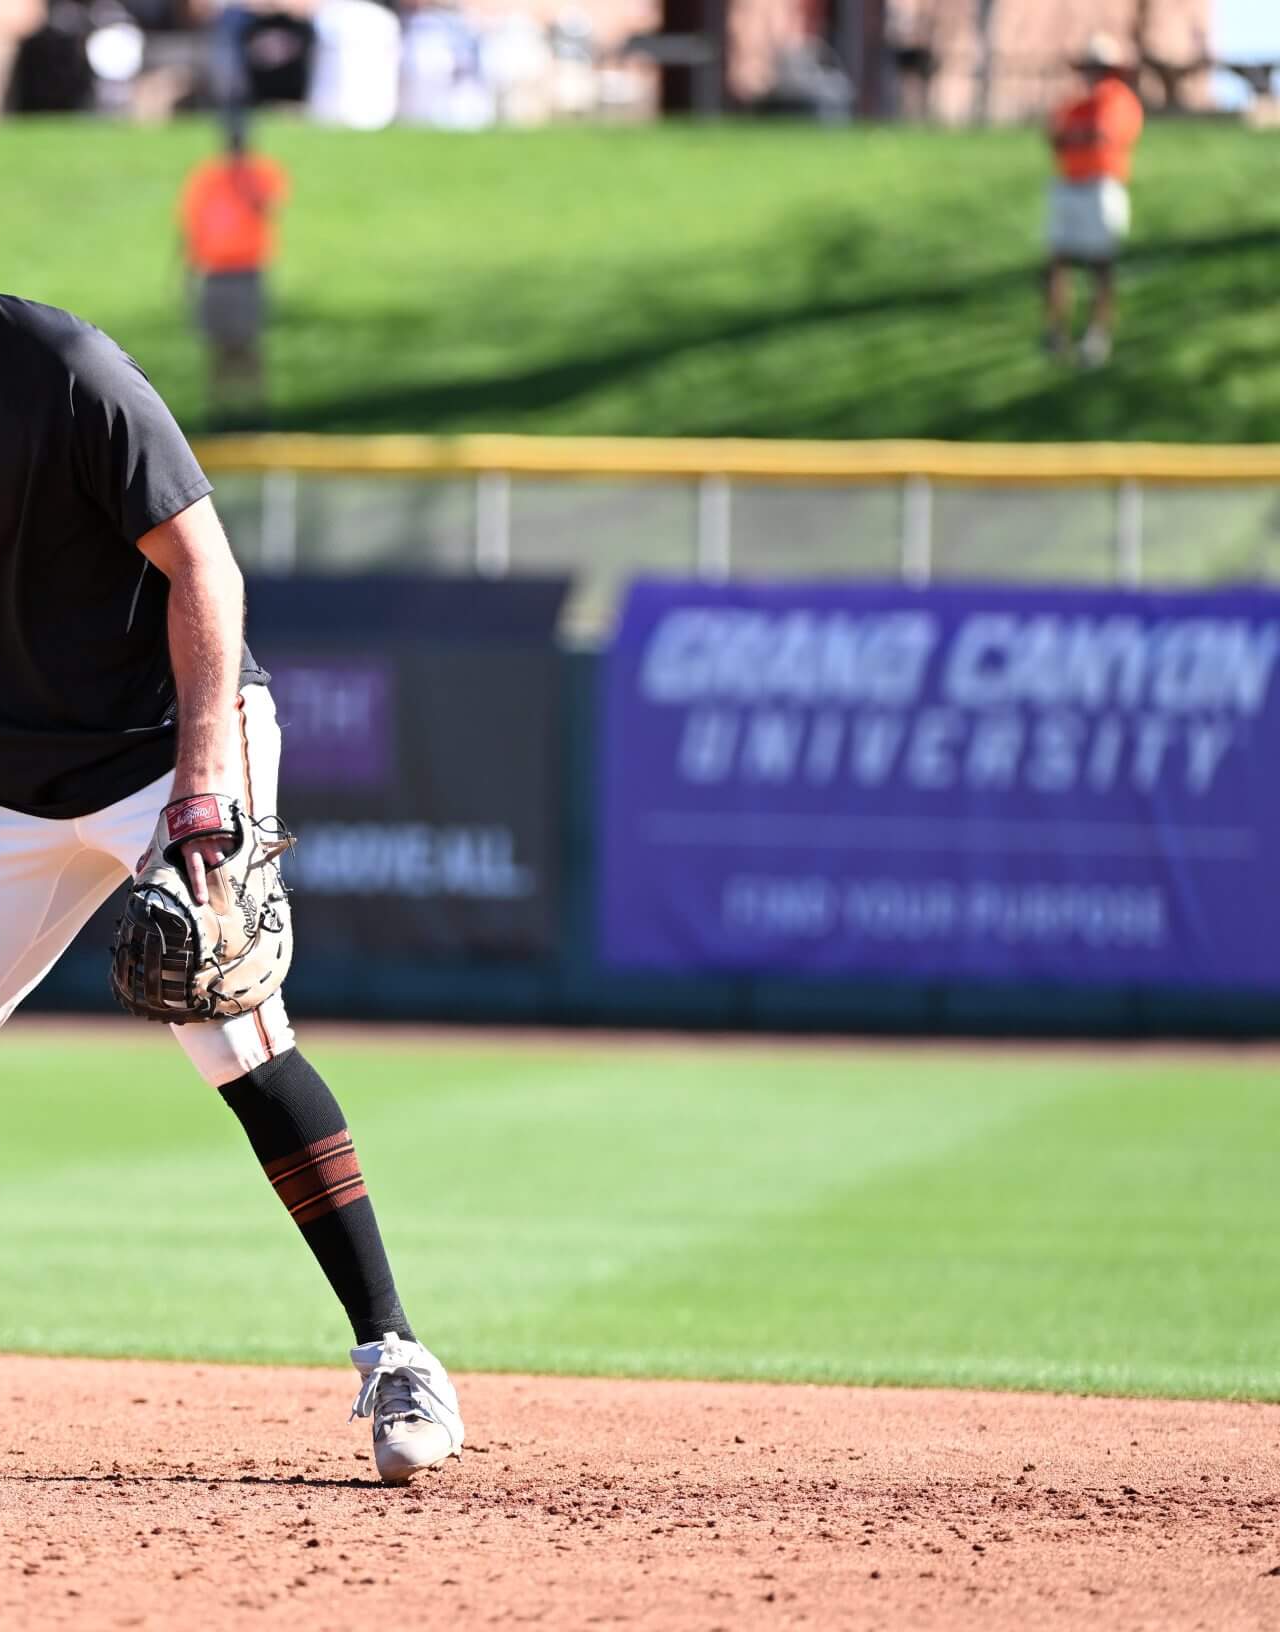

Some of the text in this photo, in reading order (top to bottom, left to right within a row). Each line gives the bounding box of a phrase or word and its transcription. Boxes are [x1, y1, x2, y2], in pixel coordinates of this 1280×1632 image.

[640, 608, 1280, 716] GRAND CANYON
[677, 708, 1233, 792] UNIVERSITY
[842, 878, 958, 943] YOUR
[963, 882, 1169, 948] PURPOSE
